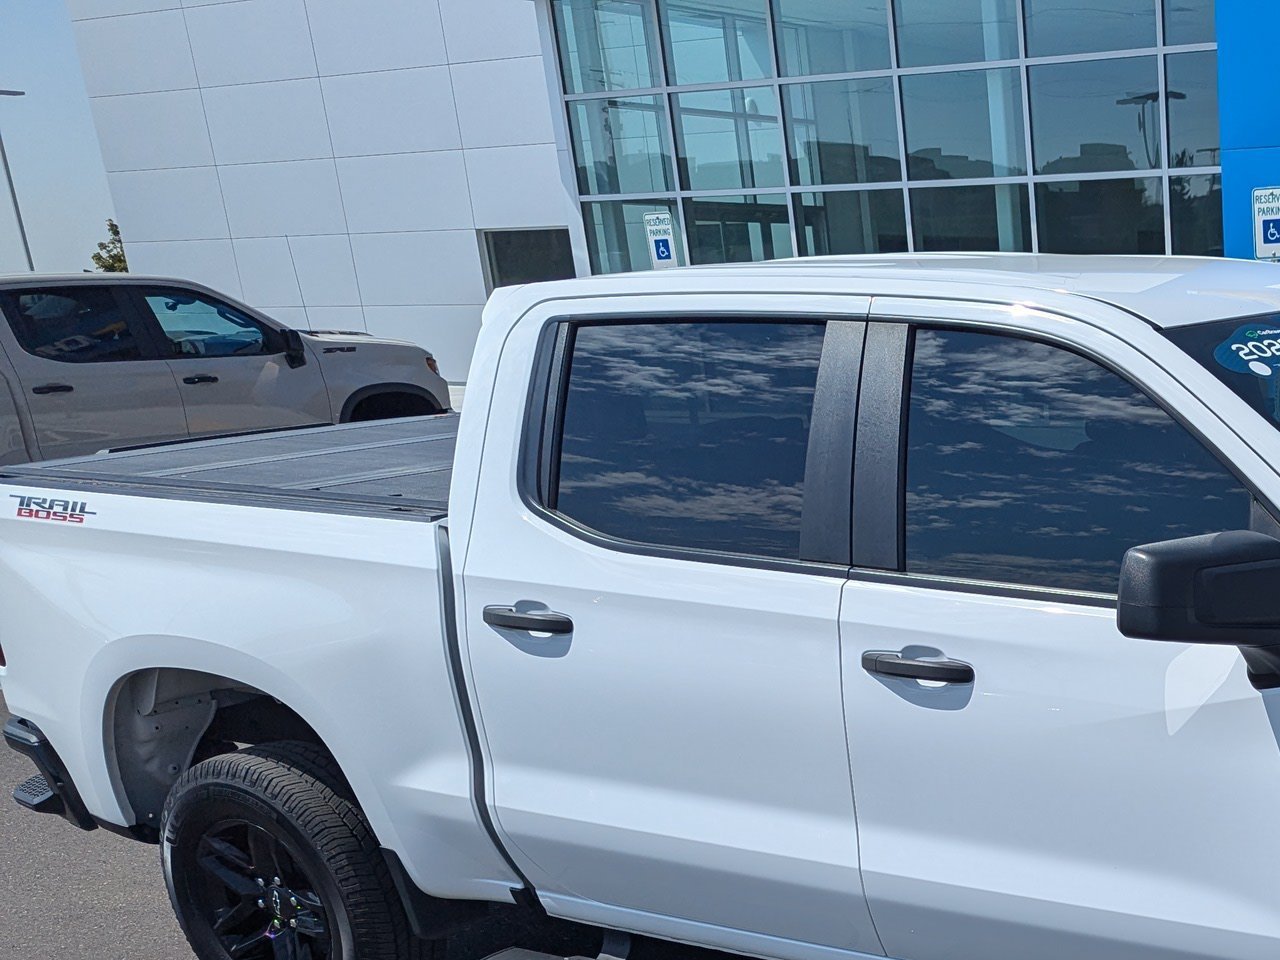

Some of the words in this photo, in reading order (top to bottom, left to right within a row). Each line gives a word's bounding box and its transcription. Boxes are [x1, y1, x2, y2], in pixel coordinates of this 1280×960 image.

[646, 217, 670, 227] RESERVED
[649, 228, 671, 237] PARKING
[9, 494, 97, 515] TRAIL
[16, 507, 85, 523] BOSS
